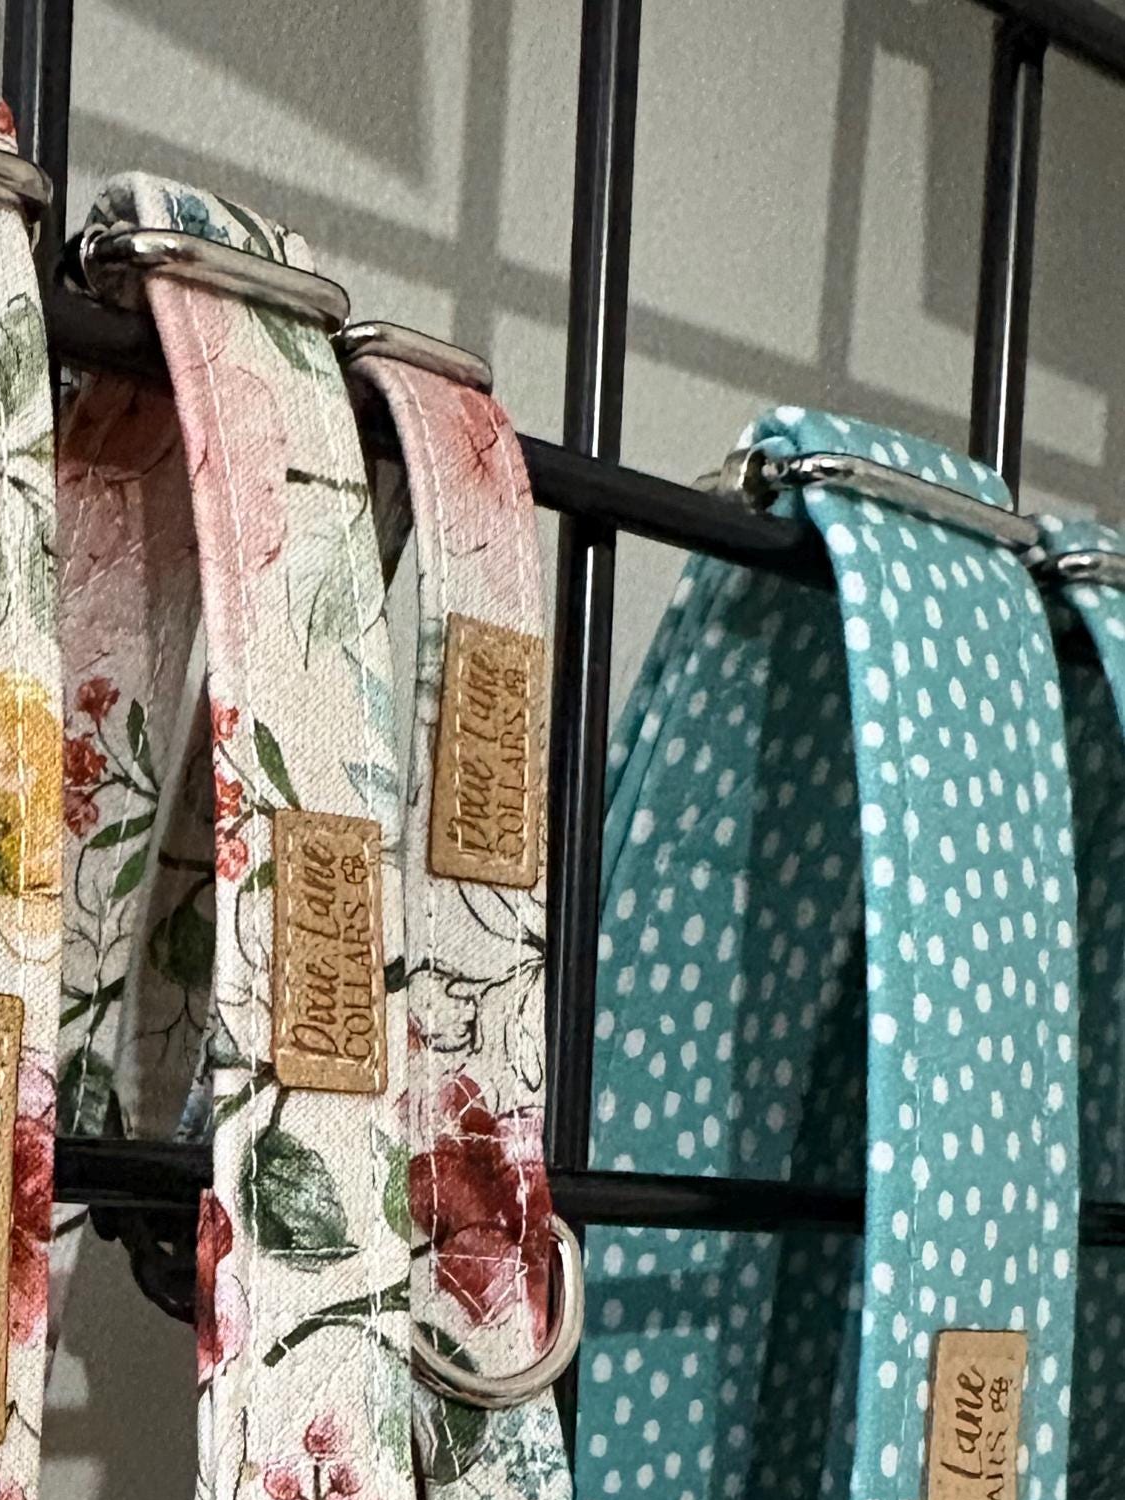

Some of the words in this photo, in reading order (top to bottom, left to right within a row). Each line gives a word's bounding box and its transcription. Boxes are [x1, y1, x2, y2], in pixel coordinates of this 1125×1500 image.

[295, 841, 341, 940] Lane
[291, 956, 340, 1055] Dixie
[342, 901, 373, 1058] COLLARS
[940, 1365, 986, 1480] Lane
